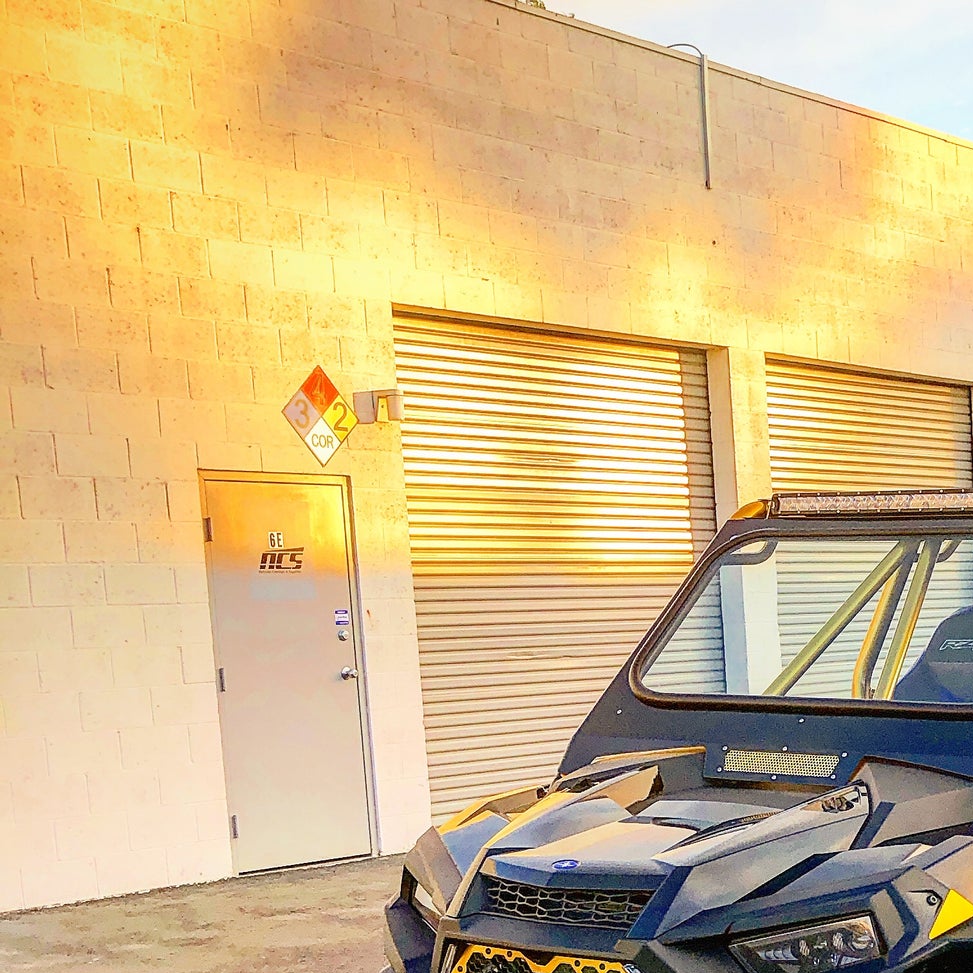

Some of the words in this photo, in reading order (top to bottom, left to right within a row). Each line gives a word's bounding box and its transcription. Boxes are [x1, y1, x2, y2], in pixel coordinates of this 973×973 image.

[310, 374, 325, 405] 4
[294, 399, 310, 428] 3
[332, 402, 349, 432] 2
[311, 434, 334, 448] COR
